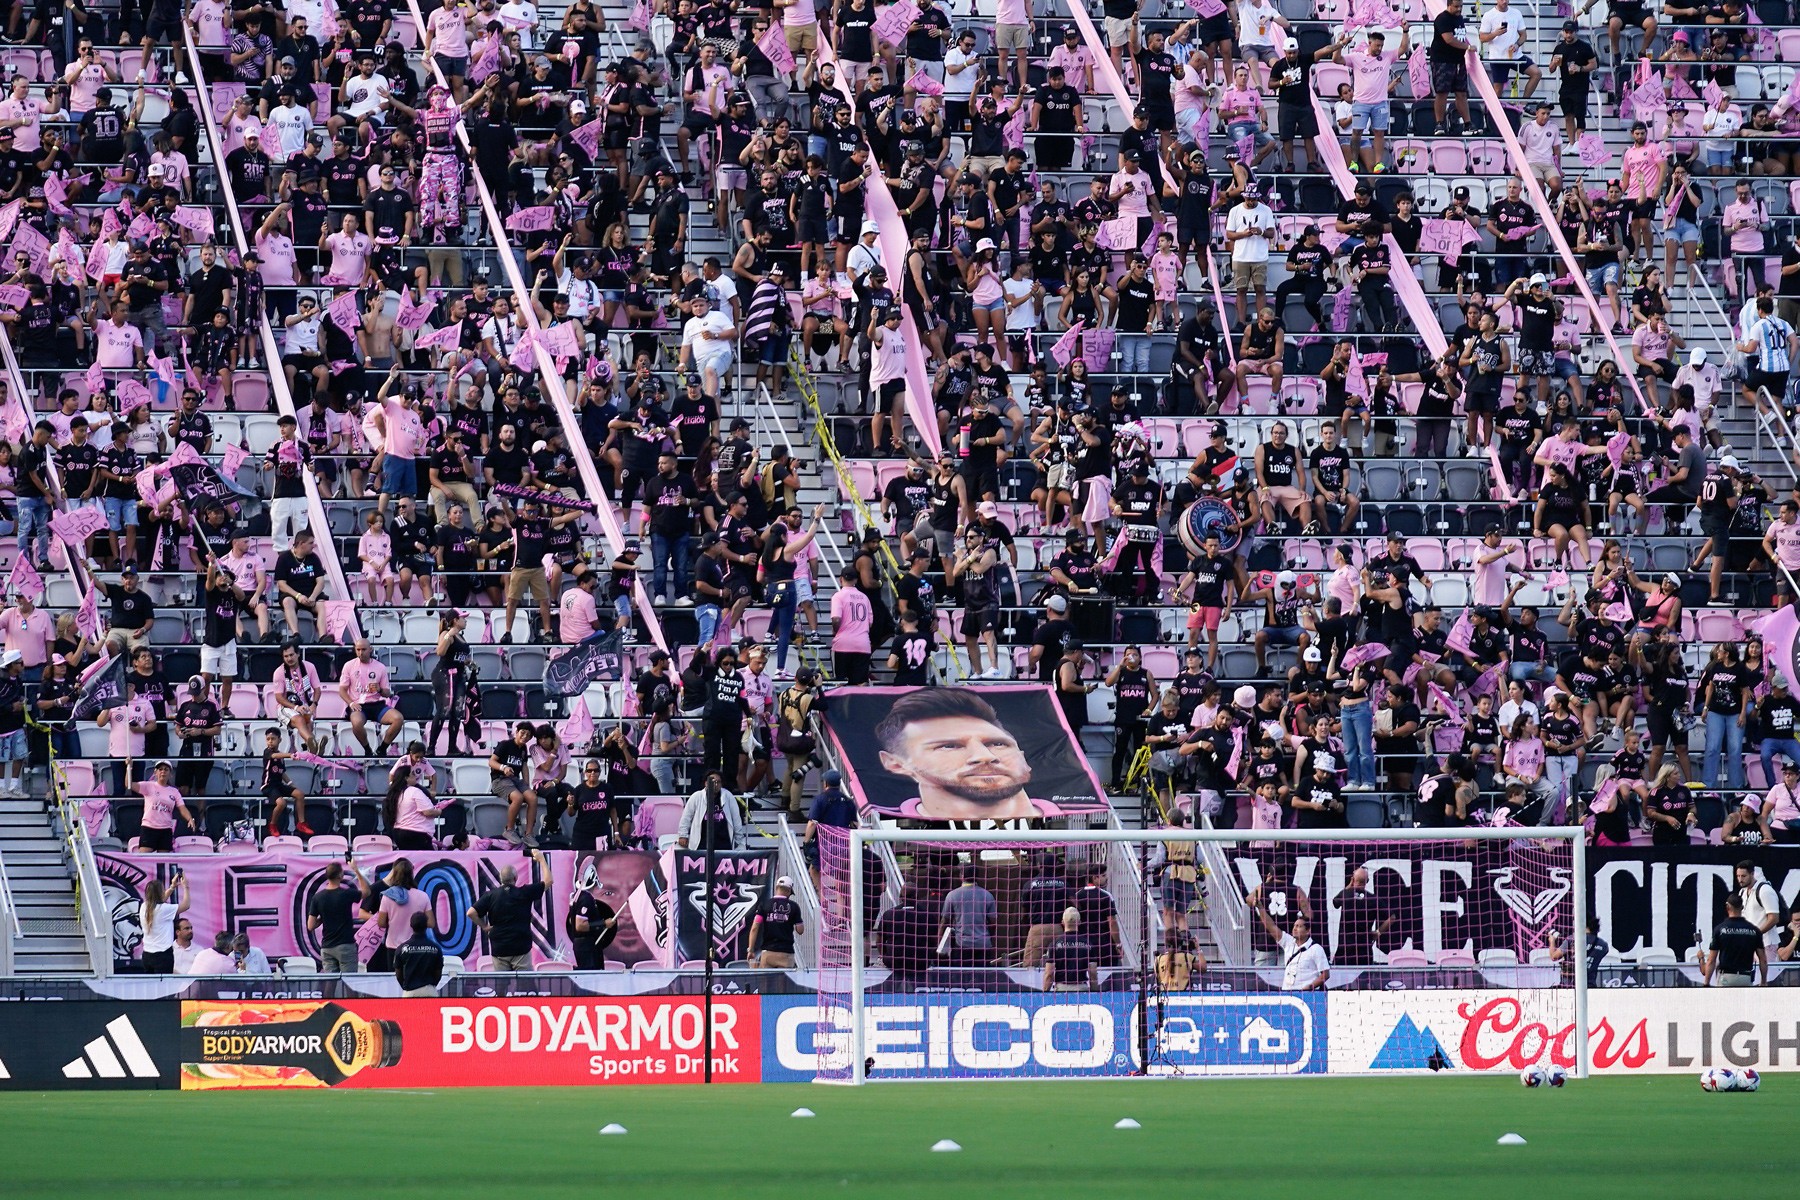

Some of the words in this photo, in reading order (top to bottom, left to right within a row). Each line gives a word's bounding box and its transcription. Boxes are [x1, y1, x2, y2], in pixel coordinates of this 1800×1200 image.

[93, 116, 119, 137] 10
[684, 416, 706, 425] LEGION
[1702, 480, 1717, 501] 10
[850, 601, 868, 622] 10
[713, 675, 743, 688] Pretend
[718, 683, 732, 693] I'm
[717, 692, 737, 703] Goat
[1119, 689, 1146, 698] MIAMI
[582, 802, 608, 811] LEGION
[684, 855, 769, 876] MAMI
[440, 1003, 739, 1053] BODYARMOR
[775, 1004, 1114, 1071] GEICO
[1457, 997, 1656, 1070] Coors
[203, 1035, 322, 1055] BODYARMOR
[590, 1055, 667, 1079] Sports
[675, 1053, 739, 1075] Drnk
